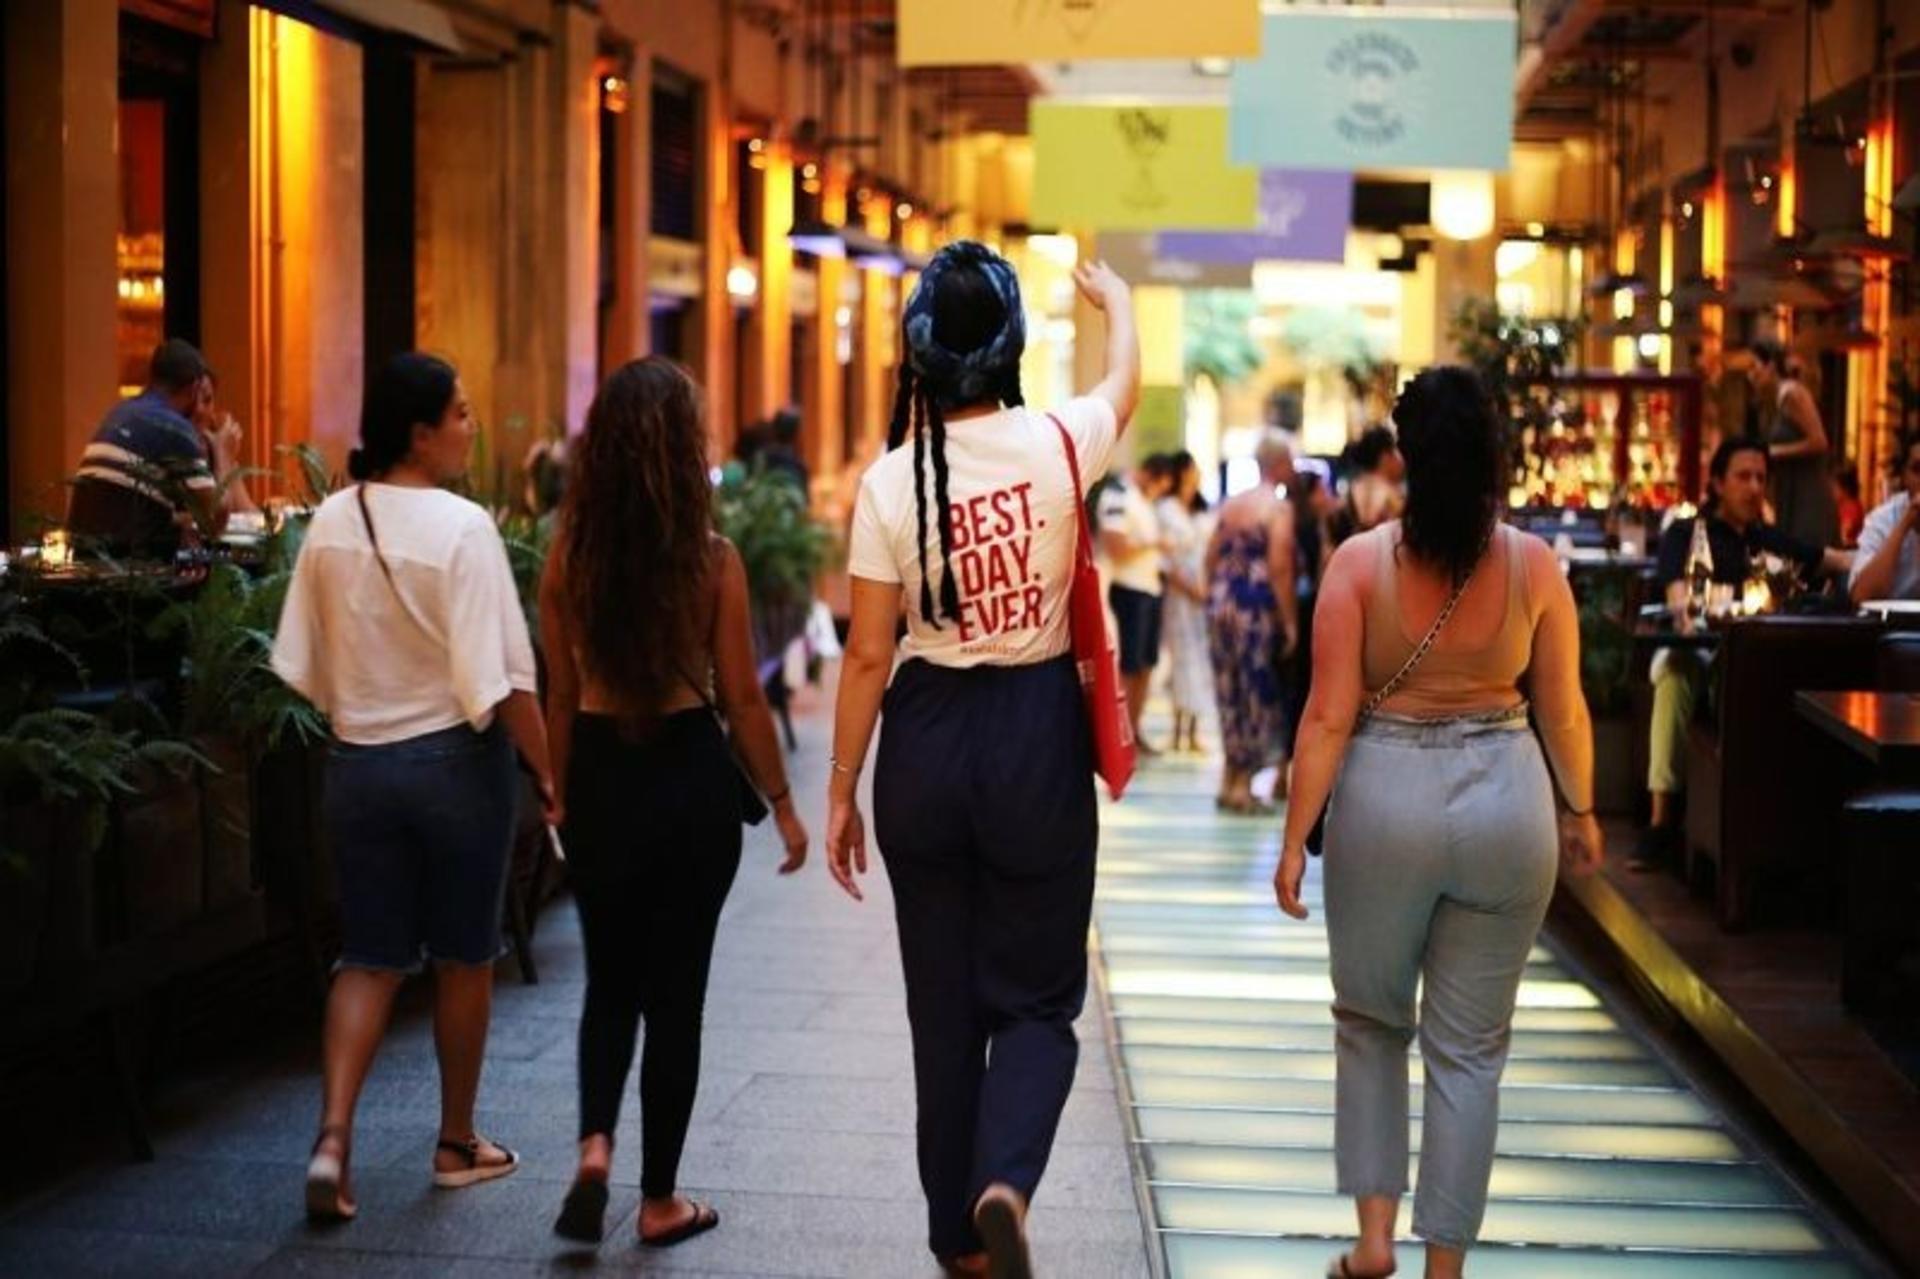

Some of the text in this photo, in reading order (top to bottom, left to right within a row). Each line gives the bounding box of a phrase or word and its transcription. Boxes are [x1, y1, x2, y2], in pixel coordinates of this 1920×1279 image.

[949, 482, 1045, 551] BEST.
[960, 535, 1041, 598] DAY.
[959, 585, 1049, 643] EVER.
